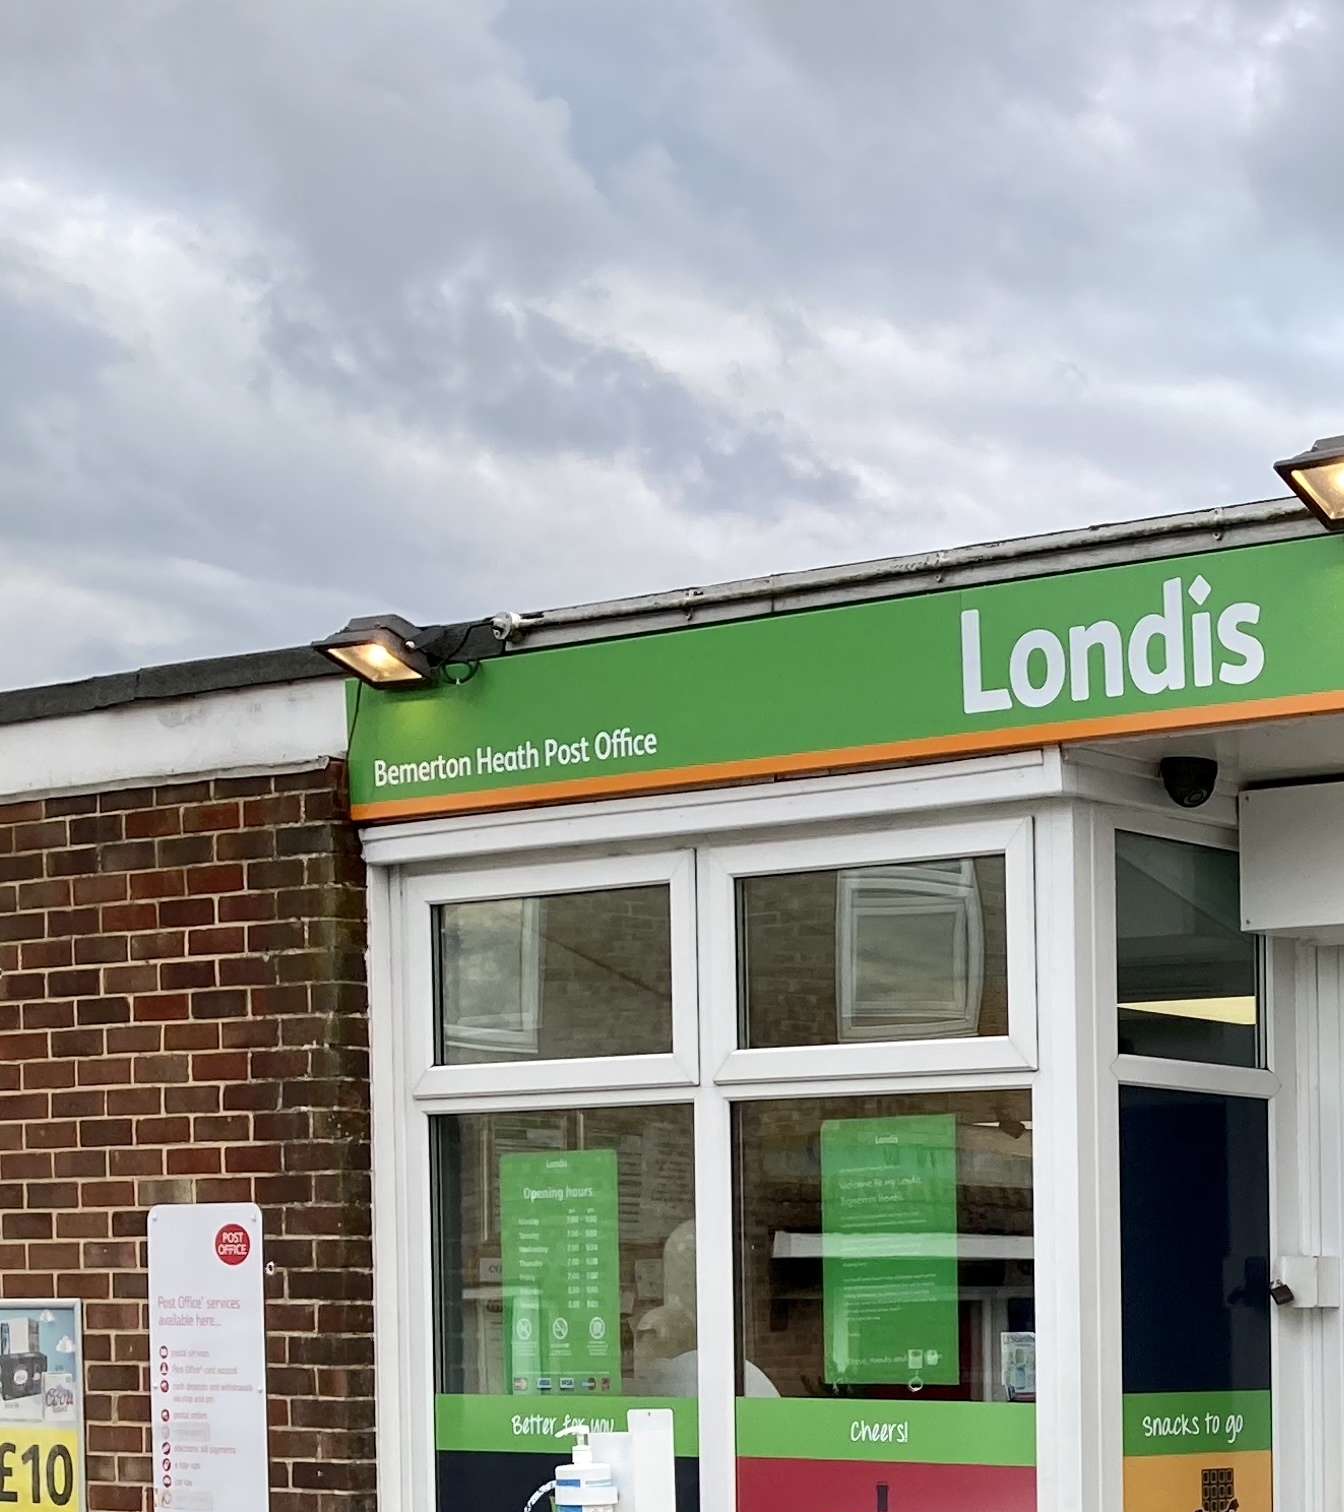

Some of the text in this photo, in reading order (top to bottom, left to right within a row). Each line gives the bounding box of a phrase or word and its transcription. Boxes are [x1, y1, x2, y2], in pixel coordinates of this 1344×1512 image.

[961, 574, 1265, 714] Londis
[374, 727, 657, 787] Bemerton Heath Post Office
[523, 1185, 593, 1202] Opening hours
[223, 1232, 244, 1243] POST
[218, 1244, 247, 1255] OFFICE
[157, 1296, 241, 1309] Post services
[158, 1313, 194, 1326] available
[511, 1414, 557, 1436] Better
[850, 1420, 909, 1443] Cheers!
[1205, 1412, 1244, 1443] to go
[0, 1442, 73, 1506] £10
